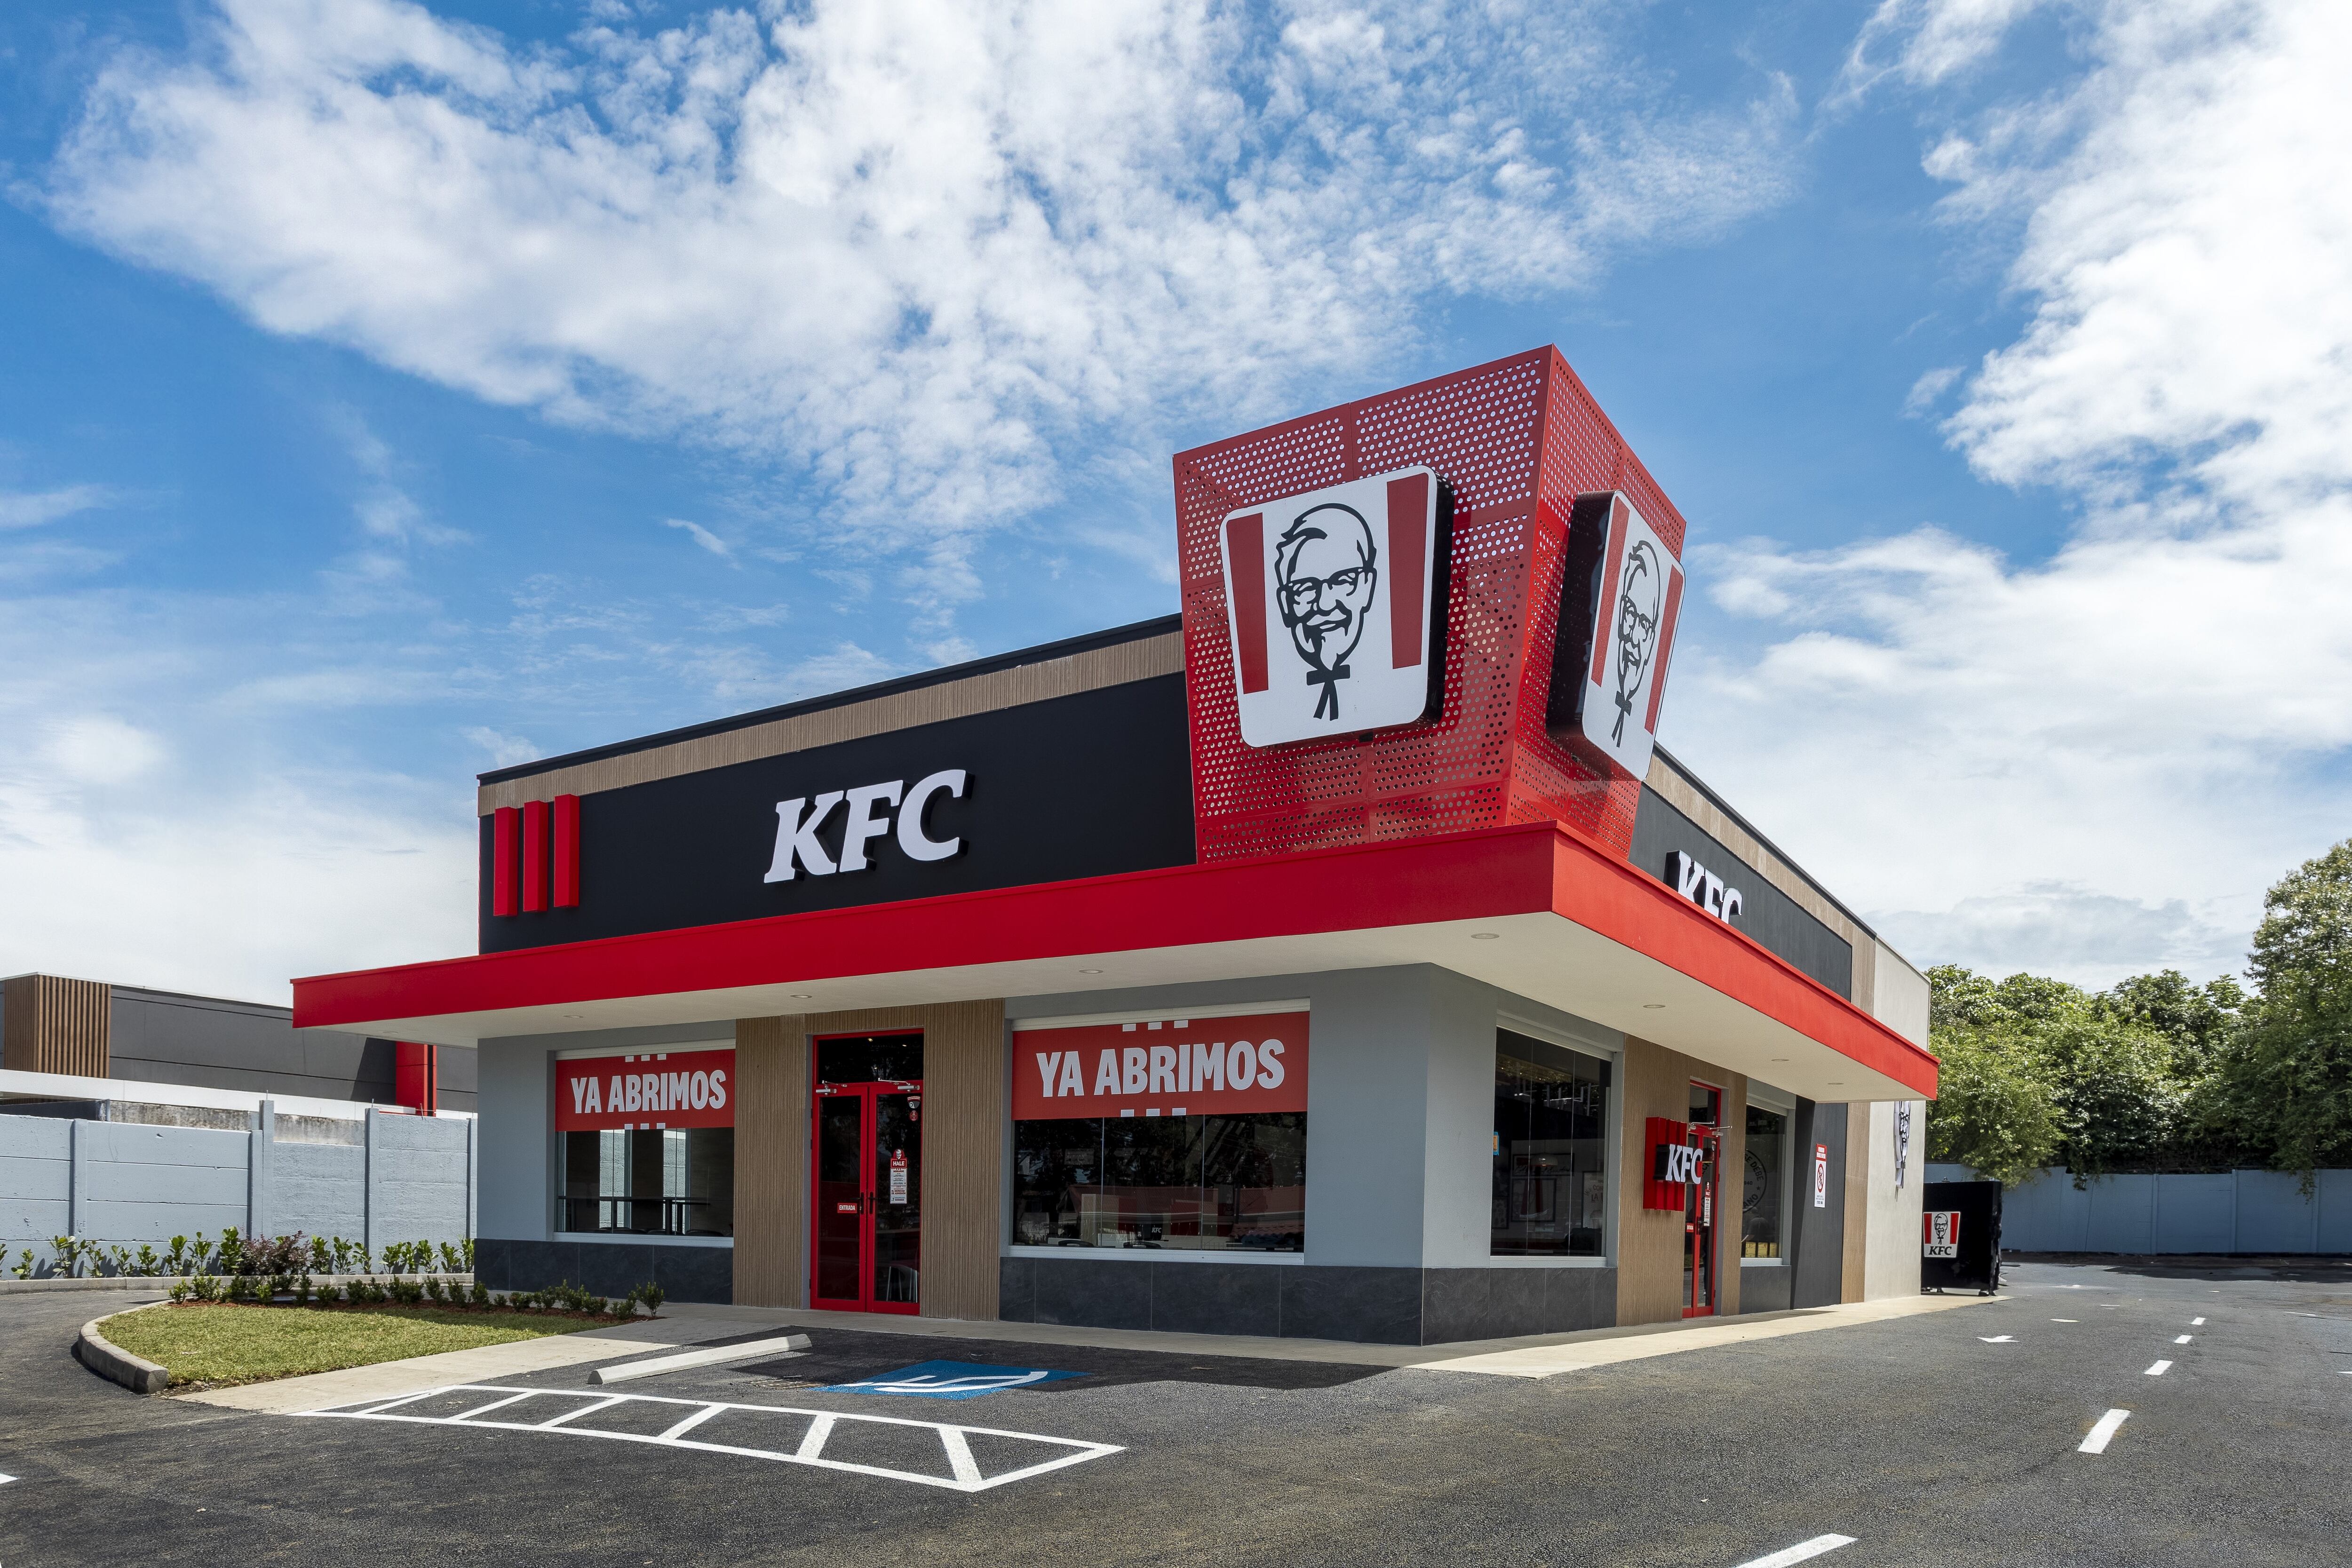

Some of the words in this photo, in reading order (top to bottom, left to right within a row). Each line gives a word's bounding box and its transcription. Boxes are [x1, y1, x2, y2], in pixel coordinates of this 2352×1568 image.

[763, 769, 967, 883] KFC
[1036, 1051, 1084, 1098] YA
[1094, 1039, 1285, 1095] ABRIMOS
[571, 1076, 602, 1114] YA
[607, 1069, 726, 1113] ABRIMOS
[1665, 1144, 1703, 1185] KFC
[1929, 1246, 1952, 1256] KFC
